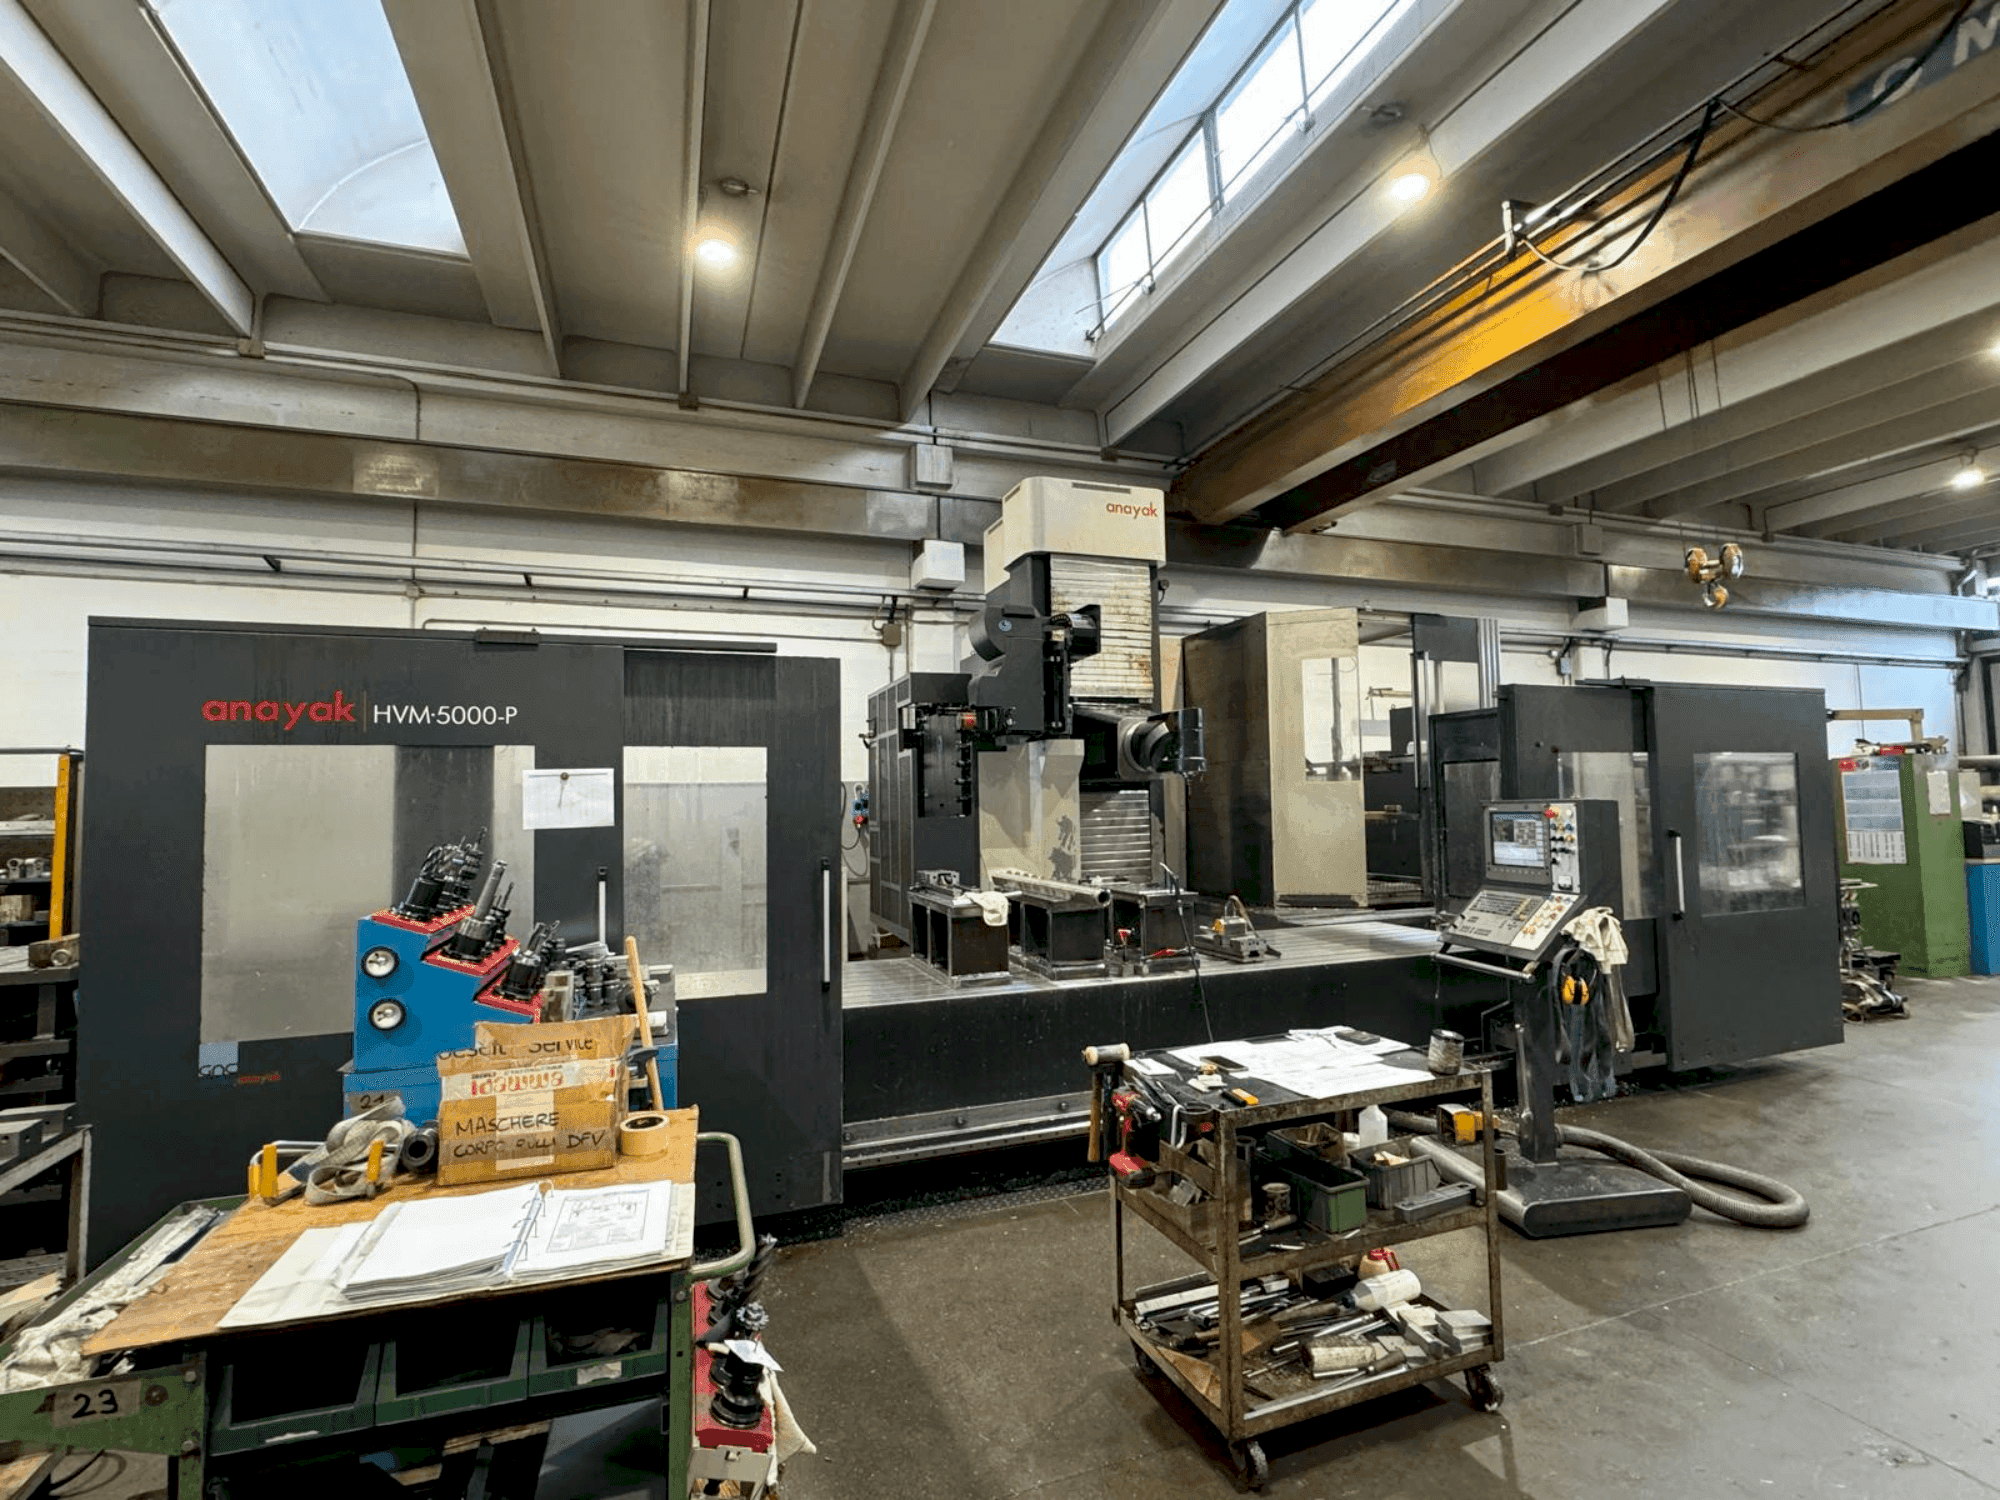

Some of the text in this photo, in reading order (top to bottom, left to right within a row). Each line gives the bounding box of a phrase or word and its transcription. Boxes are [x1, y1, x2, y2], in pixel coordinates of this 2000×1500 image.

[1106, 501, 1158, 519] anayak
[202, 689, 357, 731] anayak
[455, 1111, 560, 1137] MASCHERE
[71, 1388, 119, 1419] 23
